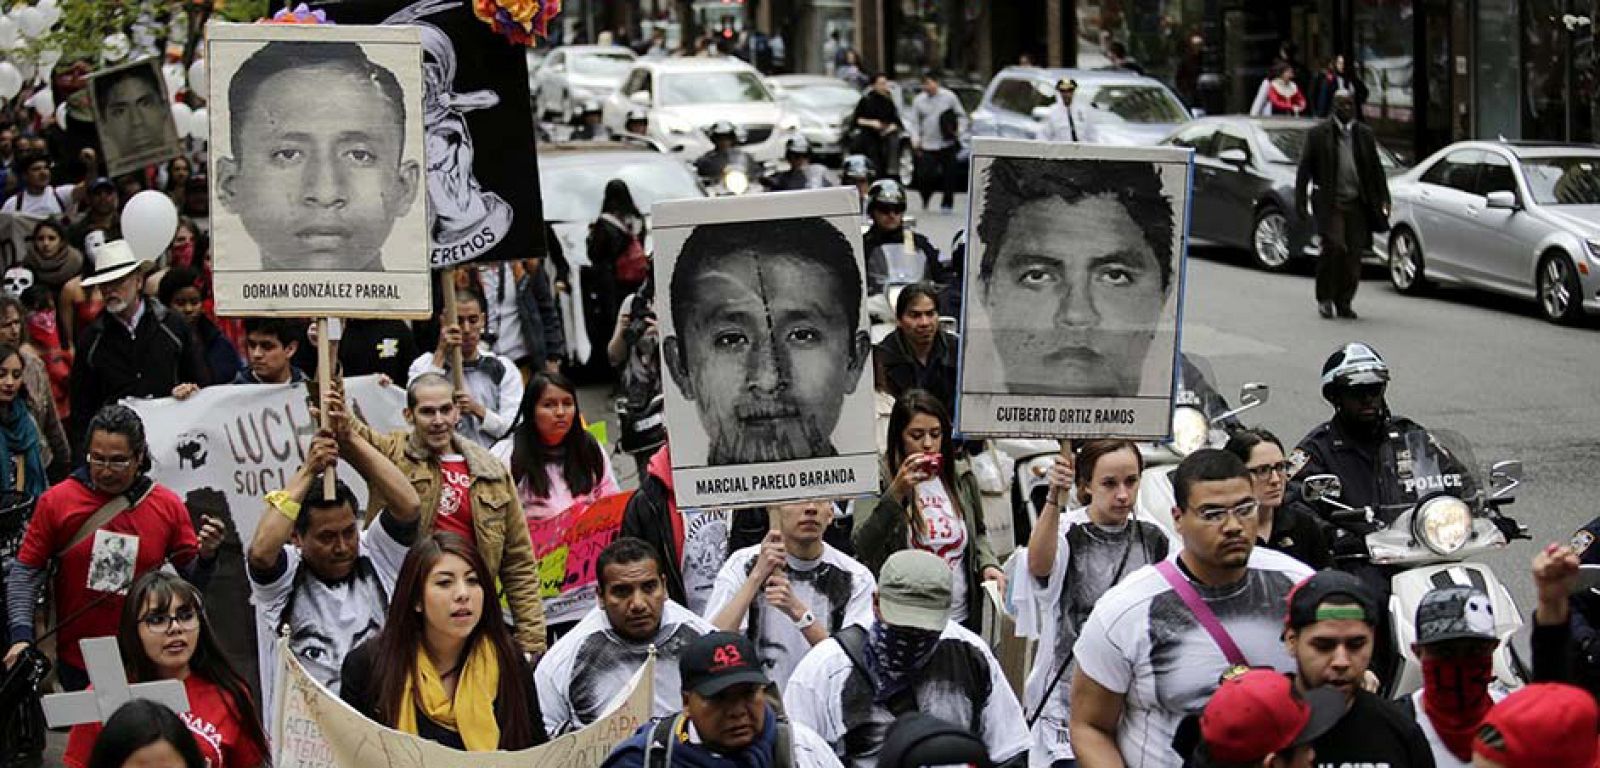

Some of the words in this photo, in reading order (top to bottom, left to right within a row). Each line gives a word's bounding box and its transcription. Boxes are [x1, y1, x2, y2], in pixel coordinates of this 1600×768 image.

[242, 283, 290, 300] DORIAM
[292, 280, 351, 299] GONZÁLEZ
[356, 284, 401, 300] PARRAL
[996, 407, 1056, 423] CUTBERTO
[1059, 408, 1092, 424] ORTIZ
[1095, 409, 1136, 425] RAMOS
[696, 476, 749, 495] MARCIAL
[752, 473, 797, 491] PARELO
[799, 468, 857, 487] BARANDA
[1403, 473, 1462, 492] POLICE
[714, 644, 741, 665] 43
